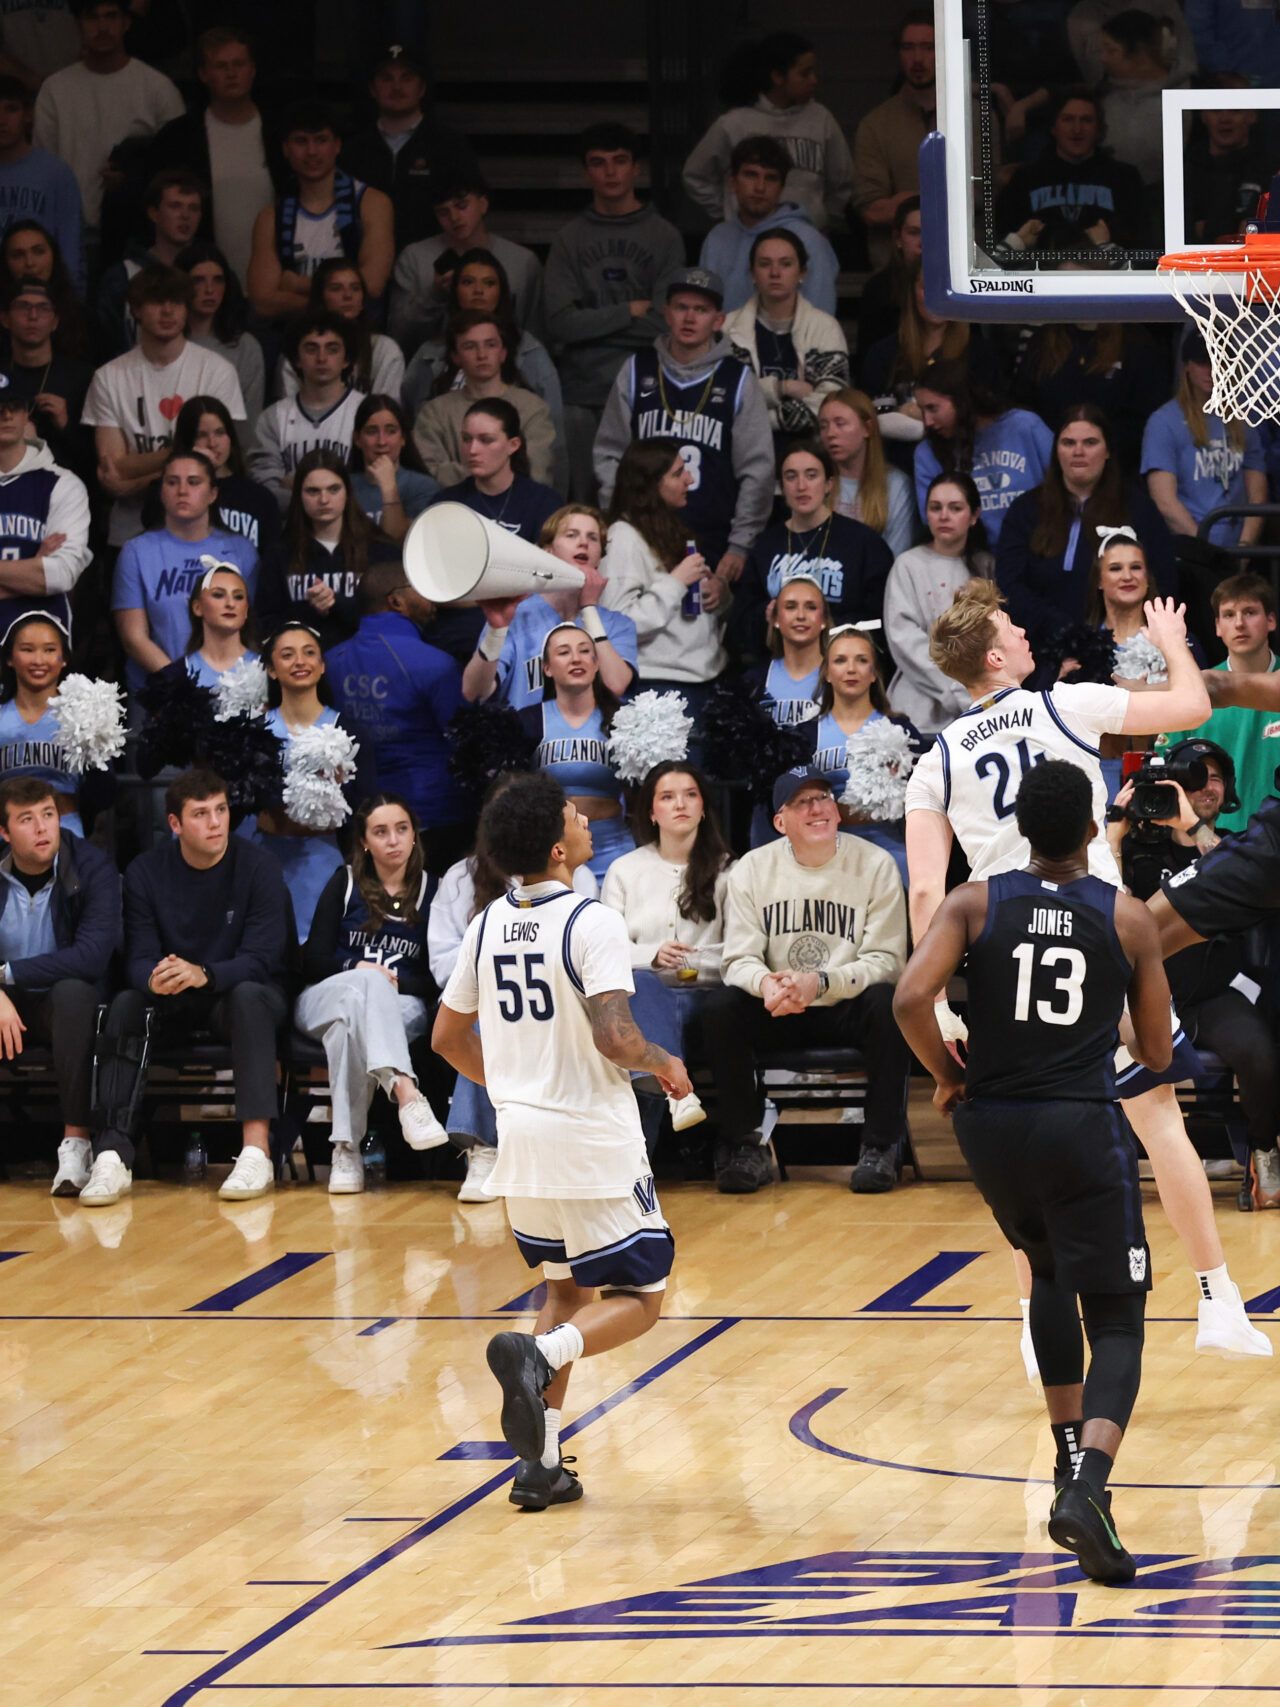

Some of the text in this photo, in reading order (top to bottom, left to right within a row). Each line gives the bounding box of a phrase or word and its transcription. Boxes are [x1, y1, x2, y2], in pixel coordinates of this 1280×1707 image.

[1029, 184, 1114, 213] VILLANOVA
[582, 239, 653, 269] VILLANOVA
[970, 279, 1033, 294] SPALDING
[136, 397, 145, 428] I
[637, 409, 723, 452] VILLANOVA
[343, 675, 388, 700] CSC
[960, 708, 1031, 752] BRENNAN
[503, 922, 540, 944] LEWIS
[762, 899, 856, 944] VILLANOVA
[1027, 908, 1073, 938] JONES
[348, 931, 422, 960] VILLANOVA
[493, 954, 555, 1022] 55
[1011, 942, 1088, 1026] 13
[632, 1175, 656, 1217] V
